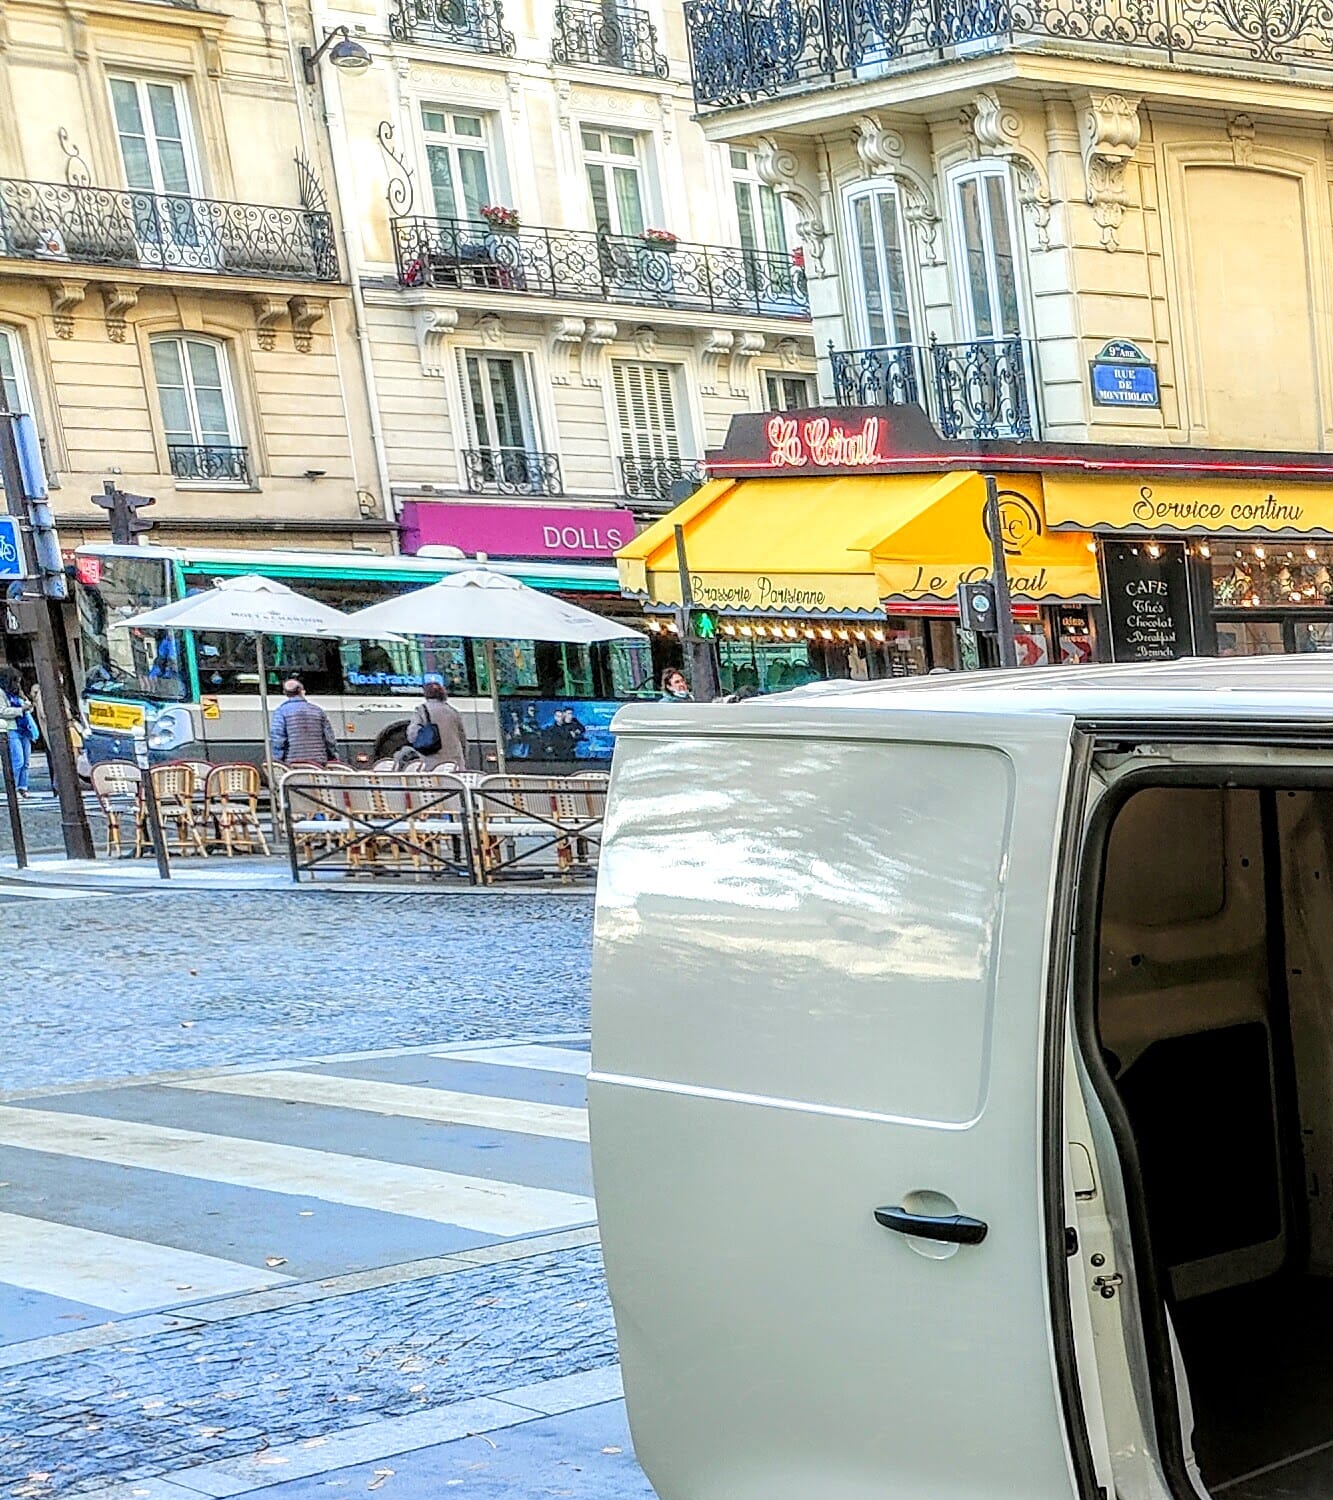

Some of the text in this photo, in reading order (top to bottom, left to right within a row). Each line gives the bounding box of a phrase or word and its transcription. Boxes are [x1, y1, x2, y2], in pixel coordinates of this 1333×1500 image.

[1114, 369, 1136, 379] RUE
[1118, 380, 1133, 390] DE
[1099, 390, 1154, 402] MONTHOLON
[1133, 486, 1303, 521] Service continu
[543, 526, 623, 550] DOLLS
[903, 566, 947, 592] Le
[692, 575, 826, 605] Brasserie Parisienne
[1126, 615, 1173, 628] Chocolat
[1126, 630, 1176, 646] Breakfast
[1135, 645, 1174, 657] Brunch
